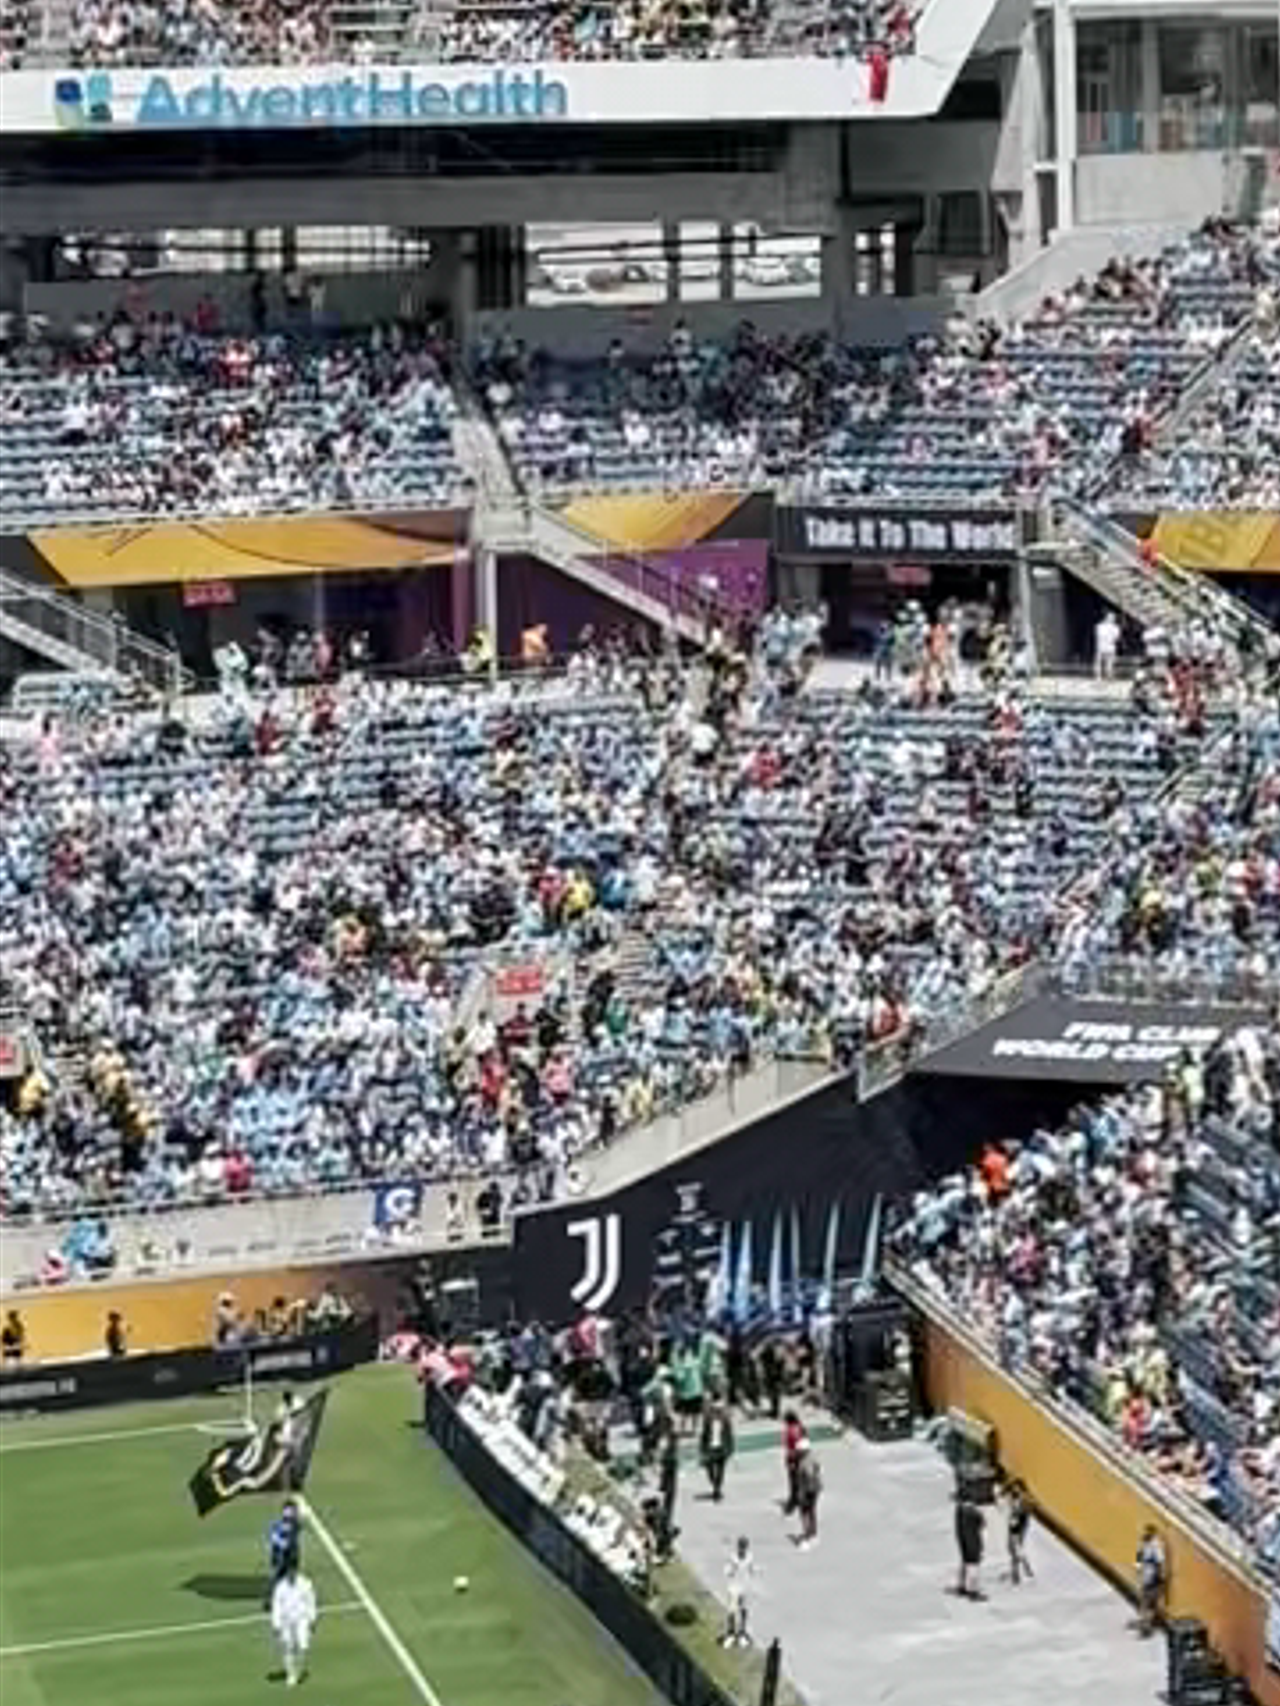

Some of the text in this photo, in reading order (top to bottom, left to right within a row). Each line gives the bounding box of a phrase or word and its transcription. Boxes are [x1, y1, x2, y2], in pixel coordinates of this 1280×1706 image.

[136, 70, 568, 123] AdventHealth
[1062, 1022, 1221, 1042] FIFA CLUB
[993, 1038, 1182, 1062] WORLD CUP
